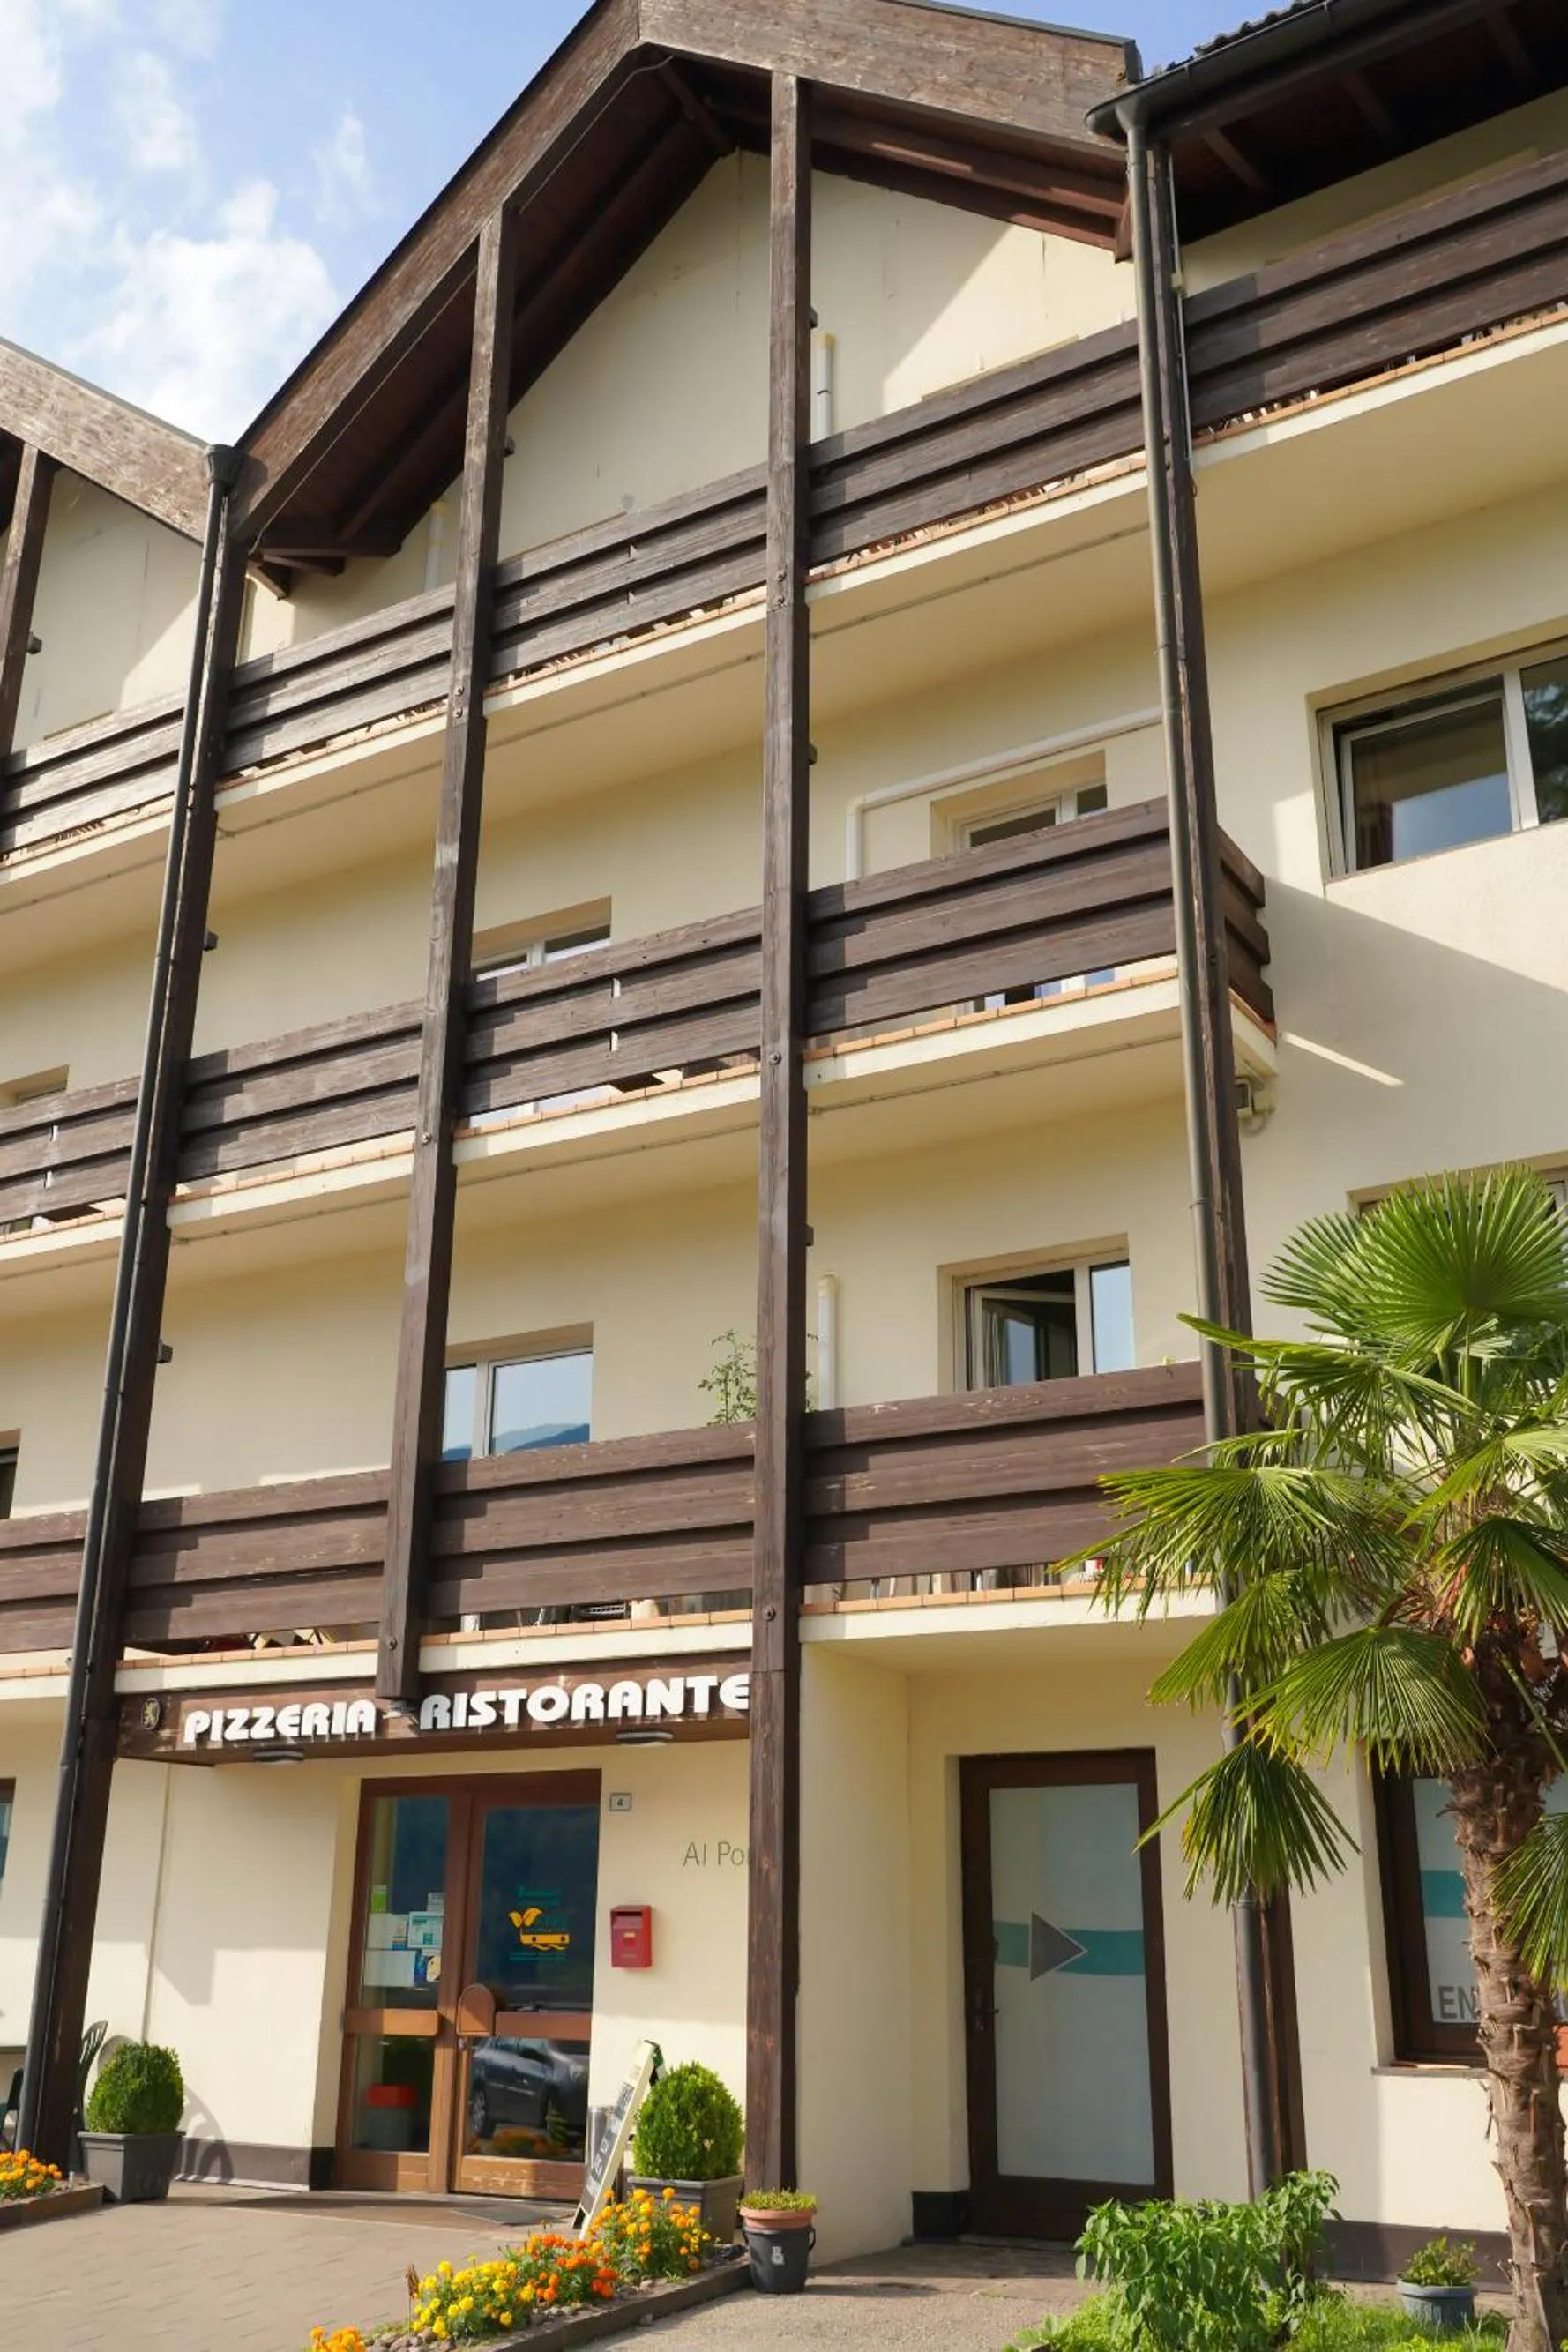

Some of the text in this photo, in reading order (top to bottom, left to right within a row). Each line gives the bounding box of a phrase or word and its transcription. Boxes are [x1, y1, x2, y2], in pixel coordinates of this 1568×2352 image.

[183, 1674, 750, 1743] PIZZERIA RISTORANTE
[718, 1841, 750, 1867] Po
